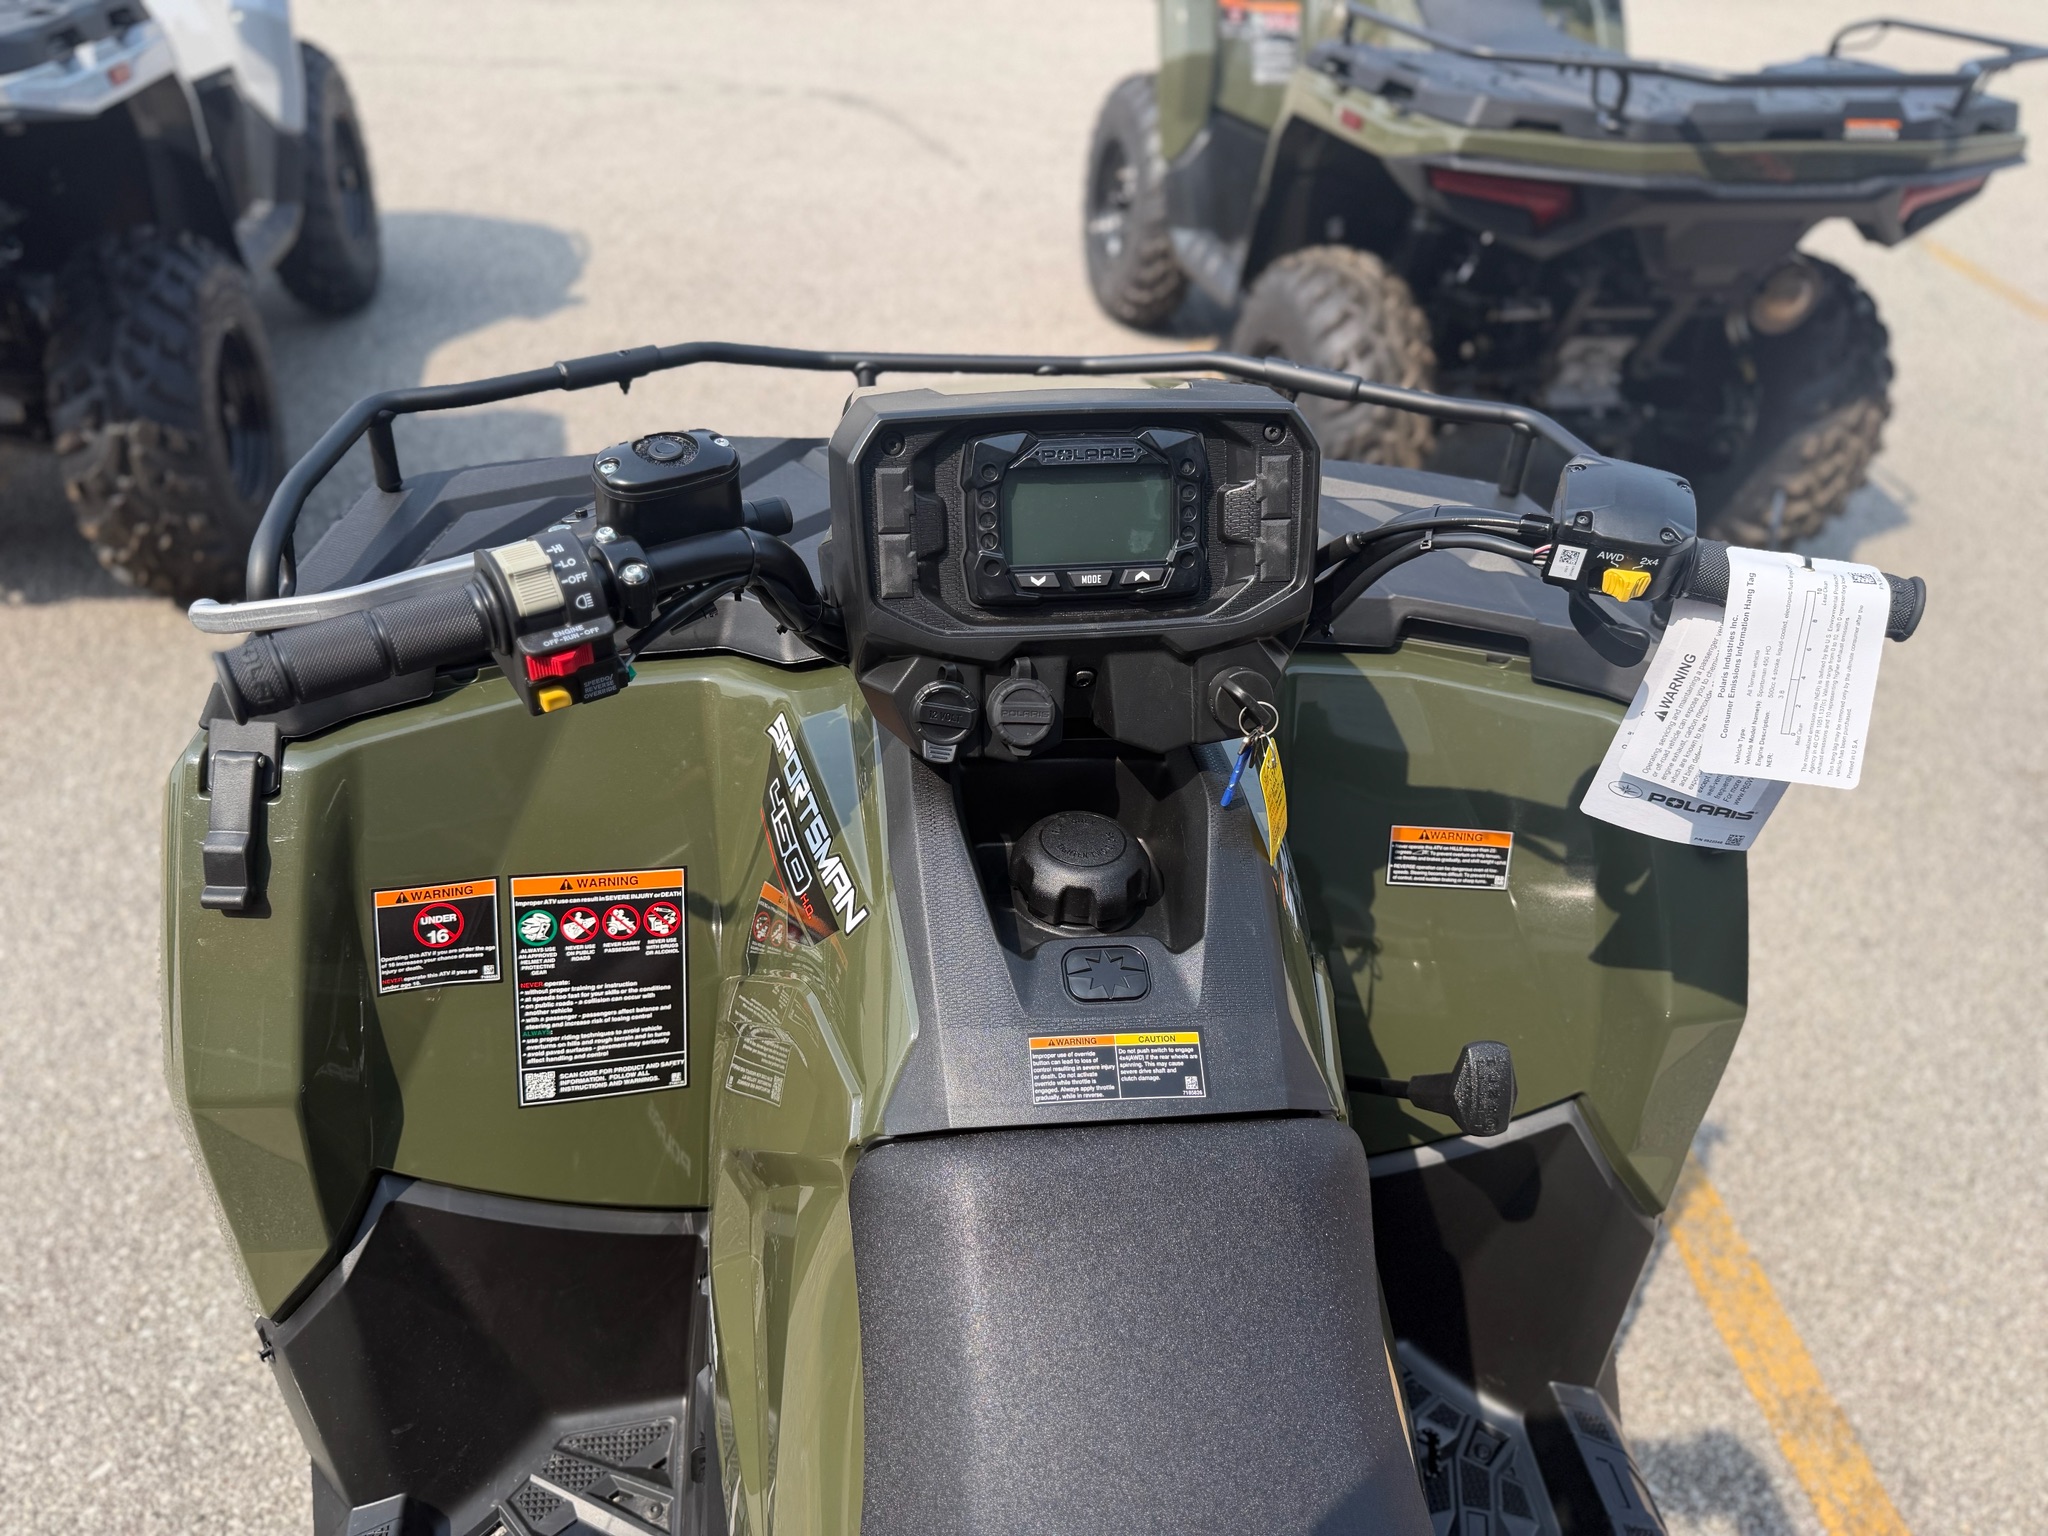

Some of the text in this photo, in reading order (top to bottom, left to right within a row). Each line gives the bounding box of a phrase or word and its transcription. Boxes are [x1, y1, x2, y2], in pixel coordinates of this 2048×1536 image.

[1043, 448, 1135, 462] POLARIS
[562, 558, 576, 568] LO
[1596, 551, 1659, 566] AWD 2x4
[568, 572, 588, 584] OFF
[1081, 574, 1102, 584] MODE
[552, 624, 584, 638] ENGINE
[1717, 613, 1739, 698] Polaris Industries Inc.
[1720, 571, 1757, 739] Consumer Emissions Information Hang Tag
[1762, 655, 1770, 666] 450
[584, 680, 614, 694] REVERSE
[1659, 652, 1697, 709] WARNING
[1757, 667, 1768, 697] Sportsman
[584, 685, 617, 699] OVERRIDE
[1641, 747, 1663, 774] Operating,
[1658, 720, 1677, 746] servicing
[1672, 708, 1682, 721] and
[1678, 675, 1701, 709] maintaining
[1698, 637, 1719, 671] passenger
[1002, 710, 1050, 718] POLARIS
[1737, 726, 1746, 742] Type:
[1748, 725, 1757, 743] Model
[1758, 709, 1771, 745] Description:
[1733, 743, 1743, 764] Vehicle
[1744, 743, 1754, 765] Vehicle
[1755, 745, 1765, 766] Engine
[1647, 792, 1753, 821] POLARIS
[768, 712, 868, 934] SPORTSMAN
[770, 778, 812, 896] 450
[1430, 831, 1483, 841] WARNING
[576, 875, 638, 888] WARNING
[410, 885, 473, 901] WARNING
[515, 899, 543, 907] Improper
[660, 890, 681, 898] DEATH
[420, 913, 457, 925] UNDER
[426, 928, 449, 944] 16
[527, 951, 557, 959] APPROVED
[603, 945, 640, 953] PASSENGERS
[380, 954, 408, 962] Operating
[520, 963, 555, 971] PROTECTIVE
[604, 980, 637, 988] instruction
[522, 1029, 552, 1037] ALWAYS:
[1138, 1034, 1176, 1042] CAUTION
[1056, 1037, 1096, 1045] WARNING
[559, 1071, 578, 1079] SCAN
[579, 1069, 598, 1077] CODE
[614, 1064, 644, 1073] PRODUCT
[660, 1059, 684, 1067] SAFETY
[559, 1075, 606, 1086] INFORMATION.
[608, 1071, 636, 1080] FOLLOW
[559, 1081, 607, 1092] INSTRUCTIONS
[623, 1075, 660, 1085] WARNINGS.
